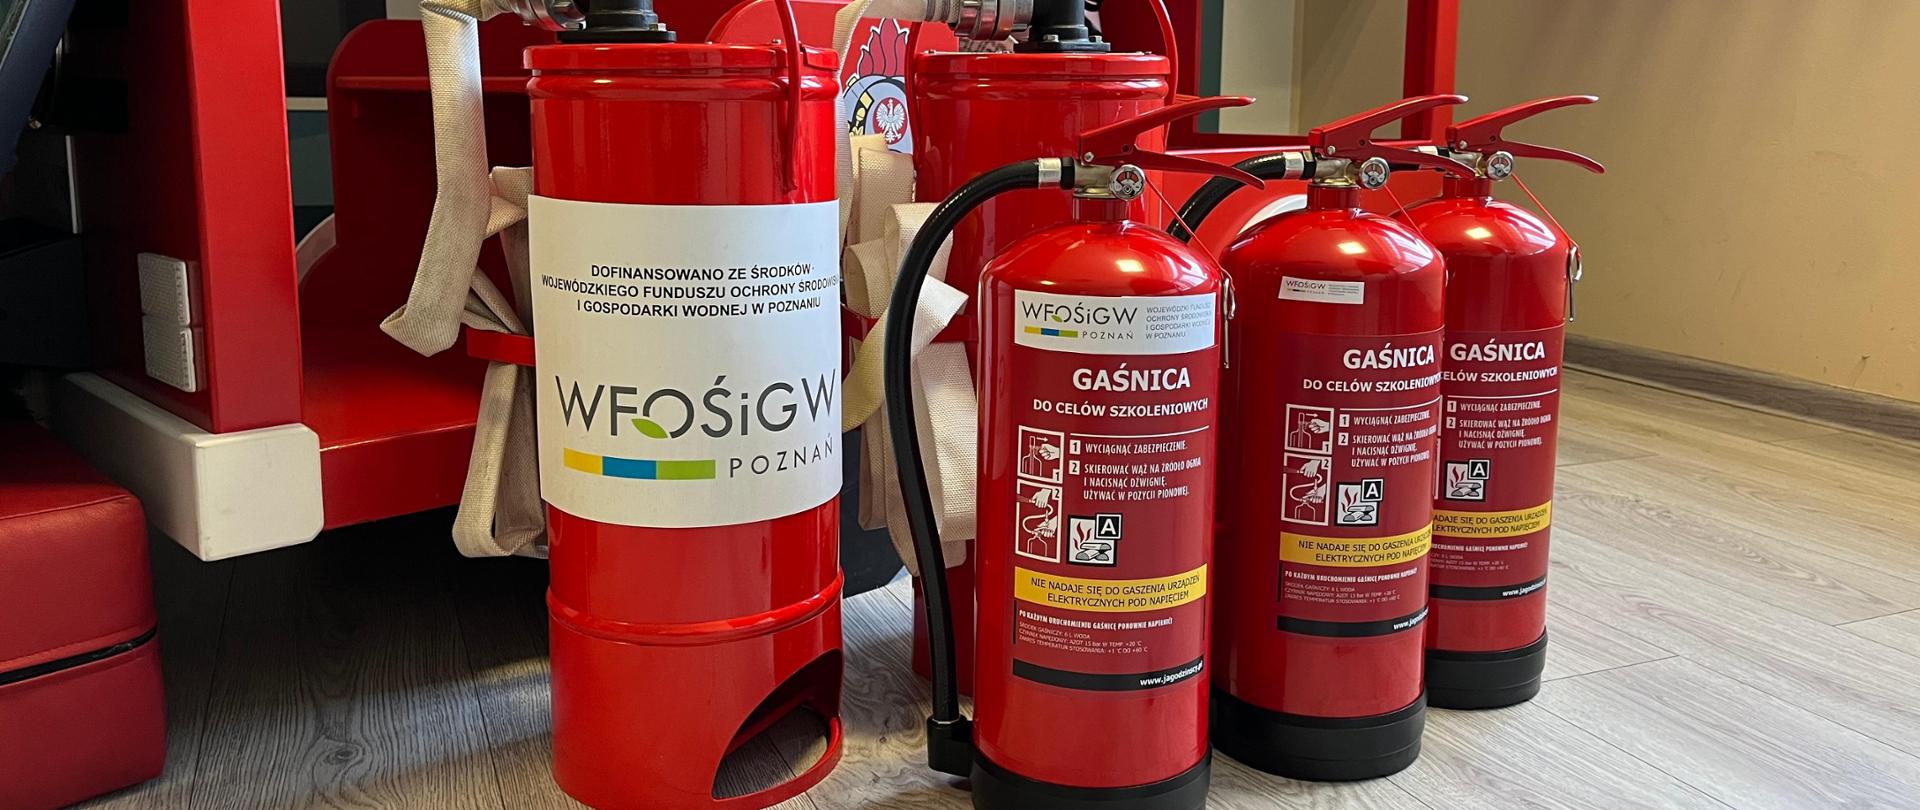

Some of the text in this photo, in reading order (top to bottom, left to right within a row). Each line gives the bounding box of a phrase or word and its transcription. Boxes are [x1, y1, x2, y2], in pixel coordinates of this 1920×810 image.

[591, 261, 811, 281] DOFINANSOWANO ZE ŚRODKÓW
[542, 274, 639, 298] WOJEWÓDZKIEGO
[643, 286, 726, 299] FUNDUSZU
[730, 283, 795, 298] OCHRONY
[577, 297, 821, 317] I GOSPODARKI WODNEJ W POZNANIU
[1022, 301, 1138, 325] WFOŚiGW
[1146, 305, 1189, 313] WOJEWÓDZKI
[1146, 314, 1180, 322] OCHRONY
[1150, 322, 1191, 331] GOSPODARKI
[1082, 331, 1134, 340] POZNAŃ
[1343, 343, 1434, 369] GAŚNICA
[1450, 338, 1545, 361] GAŚNICA
[1073, 363, 1191, 392] GAŚNICA
[1481, 366, 1558, 382] SZKOLENIOWYCH
[1303, 379, 1322, 390] DO
[1327, 378, 1372, 392] CELÓW
[555, 368, 836, 439] WFOŚiGW
[1033, 397, 1209, 418] DO CELÓW SZKOLENIOWYCH
[1450, 402, 1454, 411] 1
[1460, 402, 1498, 413] WYCIĄGNĄĆ
[1342, 416, 1347, 425] 1
[1353, 415, 1392, 427] WYCIĄGNĄĆ
[1449, 419, 1454, 427] 2
[1459, 419, 1496, 428] SKIEROWAĆ
[1340, 434, 1346, 444] 2
[1352, 433, 1390, 444] SKIEROWAĆ
[1405, 431, 1412, 440] NA
[1458, 439, 1485, 448] UŻYWAĆ
[1487, 440, 1494, 448] W
[1073, 440, 1188, 456] 1 WYCIĄGNĄĆ ZABEZPIECZENIE.
[1352, 447, 1355, 455] I
[1356, 445, 1388, 456] NACISNĄĆ
[729, 433, 833, 478] POZNAŃ
[1351, 456, 1379, 467] UŻYWAĆ
[1380, 458, 1386, 466] W
[1071, 462, 1078, 473] 2
[1084, 463, 1129, 475] SKIEROWAĆ
[1132, 463, 1147, 476] WĄŻ
[1150, 464, 1160, 474] NA
[1472, 463, 1485, 476] A
[1083, 477, 1087, 486] I
[1089, 476, 1128, 489] NACISNĄĆ
[1054, 488, 1060, 498] 2
[1083, 489, 1116, 501] UŻYWAĆ
[1118, 491, 1126, 500] W
[1366, 483, 1379, 497] A
[1100, 518, 1116, 535] A
[1433, 514, 1458, 523] ADAJE
[1460, 516, 1473, 525] SIĘ
[1475, 516, 1488, 524] DO
[1489, 514, 1523, 524] GASZENIA
[1432, 524, 1492, 534] LEKTRYCZNYCH
[1494, 525, 1509, 533] POD
[1298, 538, 1414, 553] NIE NADAJE SIĘ DO GASZENIA
[1315, 553, 1385, 564] ELEKTRYCZNYCH
[1386, 552, 1401, 561] POD
[1031, 572, 1200, 596] NIE NADAJE SIĘ DO GASZENIA URZĄDZEŃ
[1047, 590, 1189, 608] ELEKTRYCZNYCH POD NAPIĘCIEM
[1019, 609, 1026, 618] PO
[1026, 611, 1048, 623] KAŻDYM
[1093, 621, 1117, 631] GAŚNICĘ
